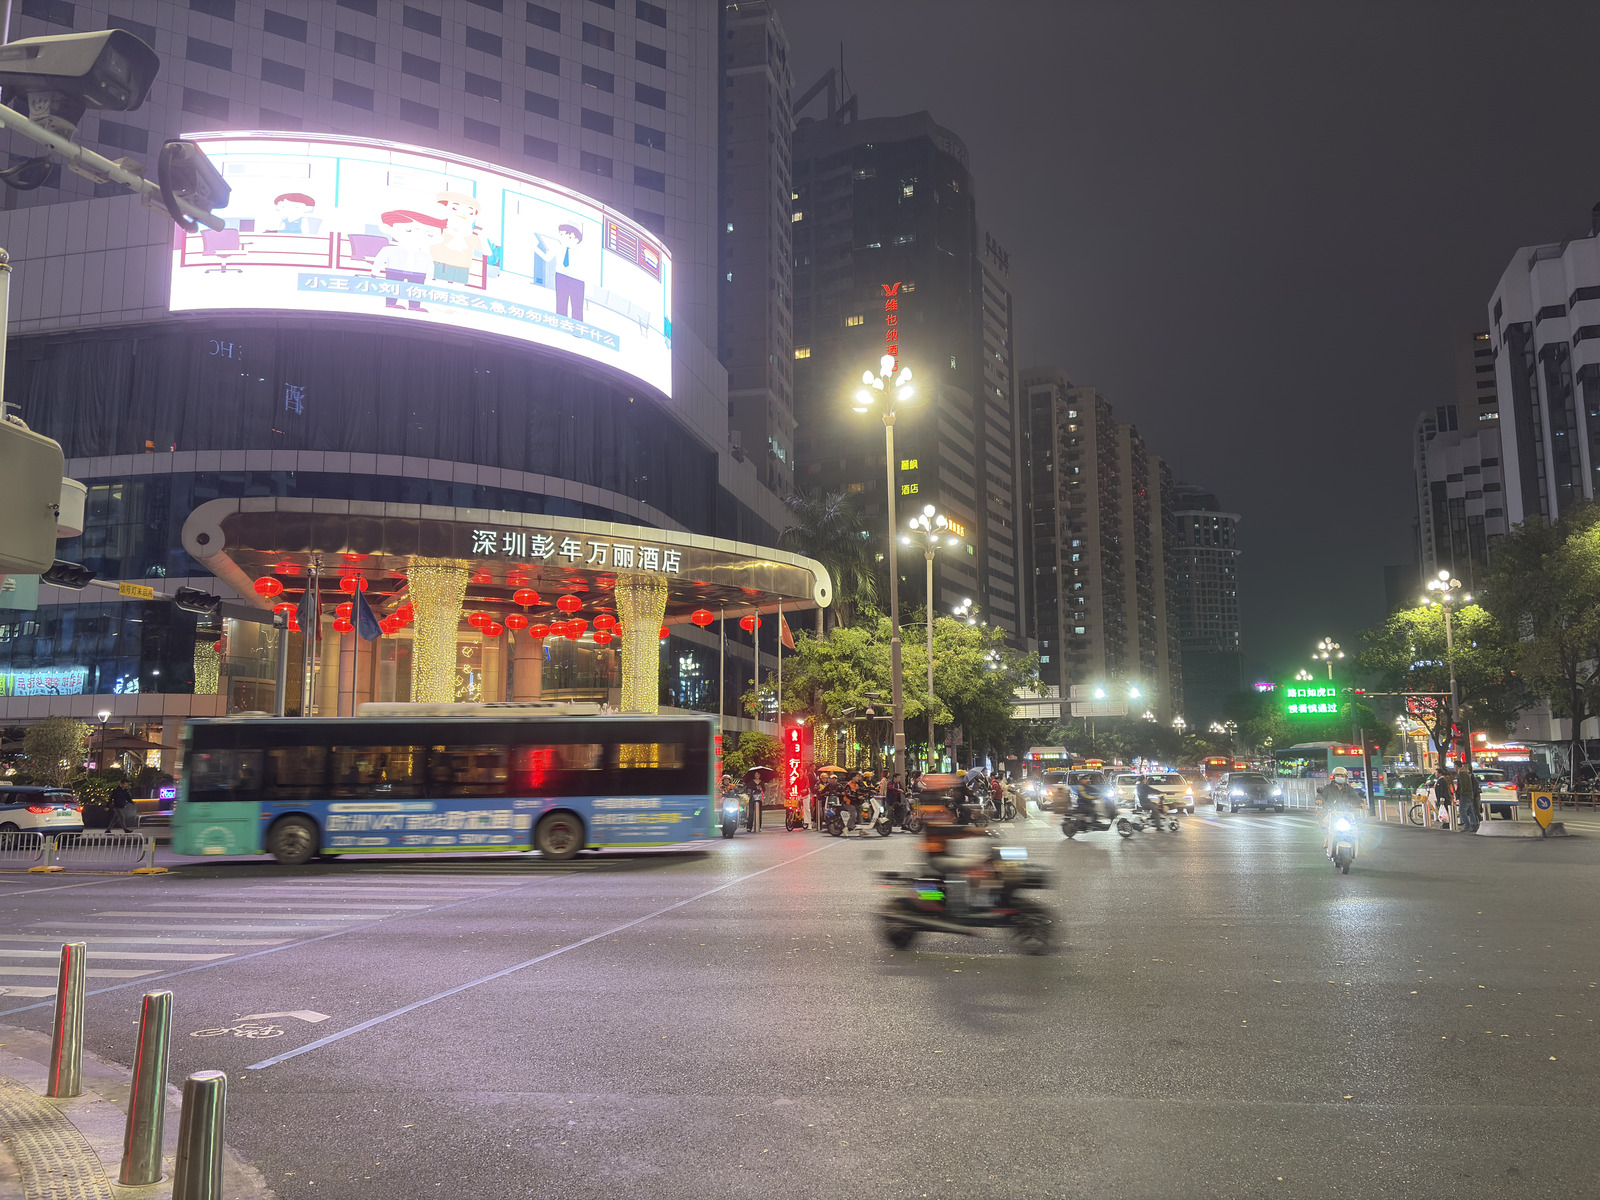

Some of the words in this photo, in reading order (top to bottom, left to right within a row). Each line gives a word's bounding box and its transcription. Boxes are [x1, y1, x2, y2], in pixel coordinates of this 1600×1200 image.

[305, 277, 350, 290] 小王
[355, 280, 401, 296] 小刘
[406, 285, 617, 348] 你俩这么急匆匆地去干什么
[885, 299, 899, 372] 维也纳酒
[901, 484, 918, 495] 酒店
[471, 529, 681, 573] 深圳彭年万丽酒店
[1287, 688, 1336, 697] 路口如虎口
